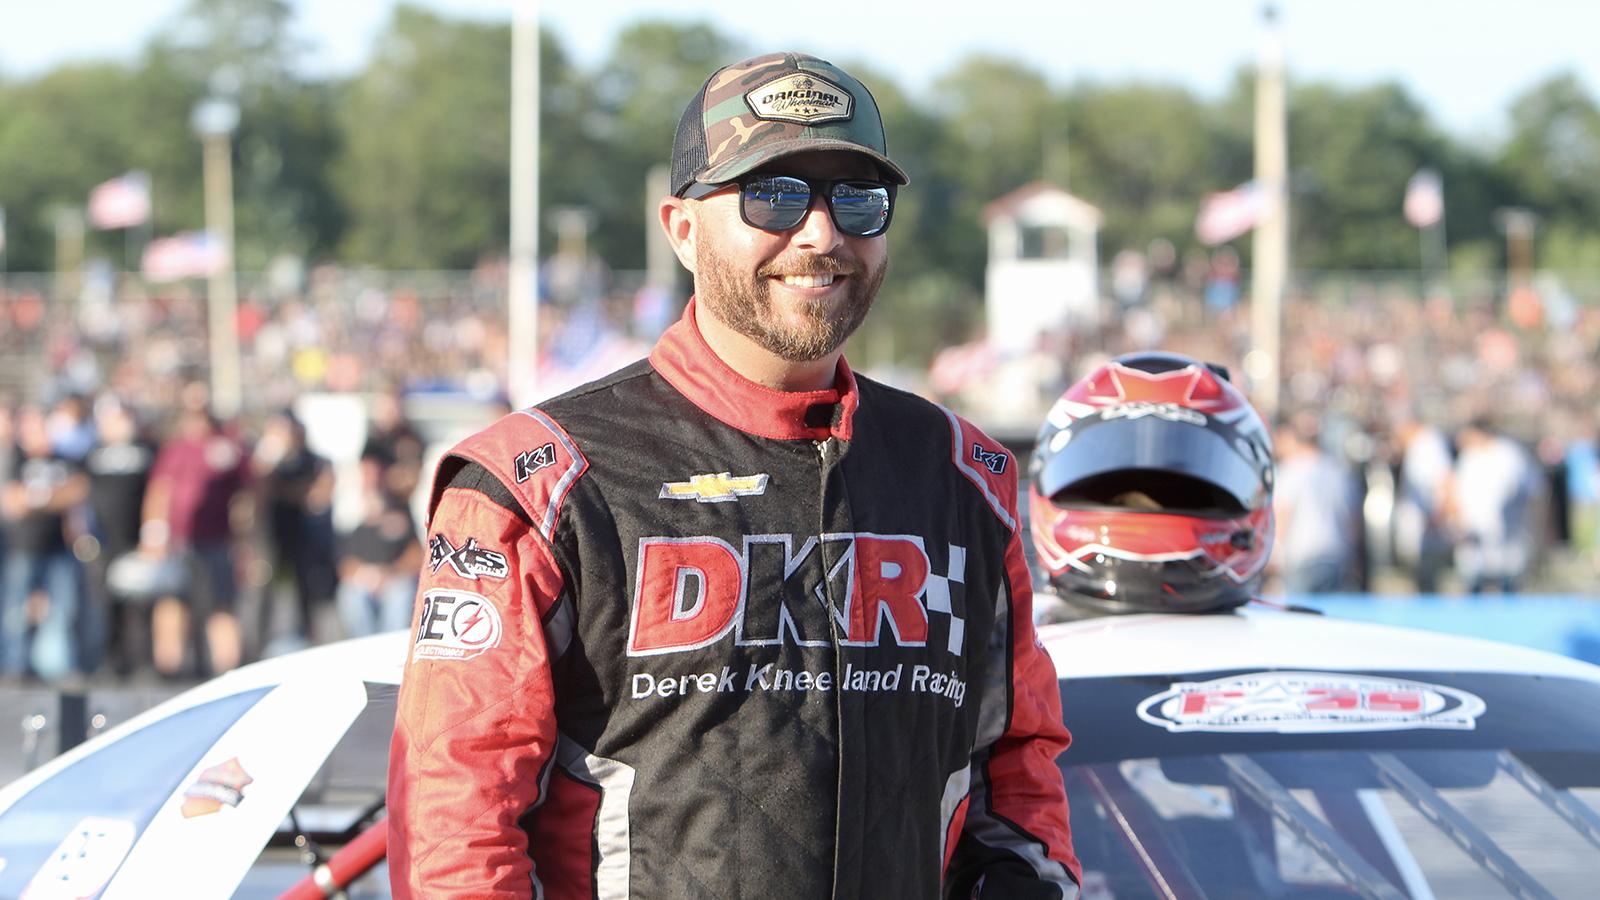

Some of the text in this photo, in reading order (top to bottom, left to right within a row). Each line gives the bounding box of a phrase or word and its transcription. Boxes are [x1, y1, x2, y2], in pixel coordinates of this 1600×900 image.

[762, 89, 843, 106] ORIGINAL
[627, 531, 932, 657] DKR
[631, 662, 738, 700] Derek
[910, 664, 967, 708] Racing
